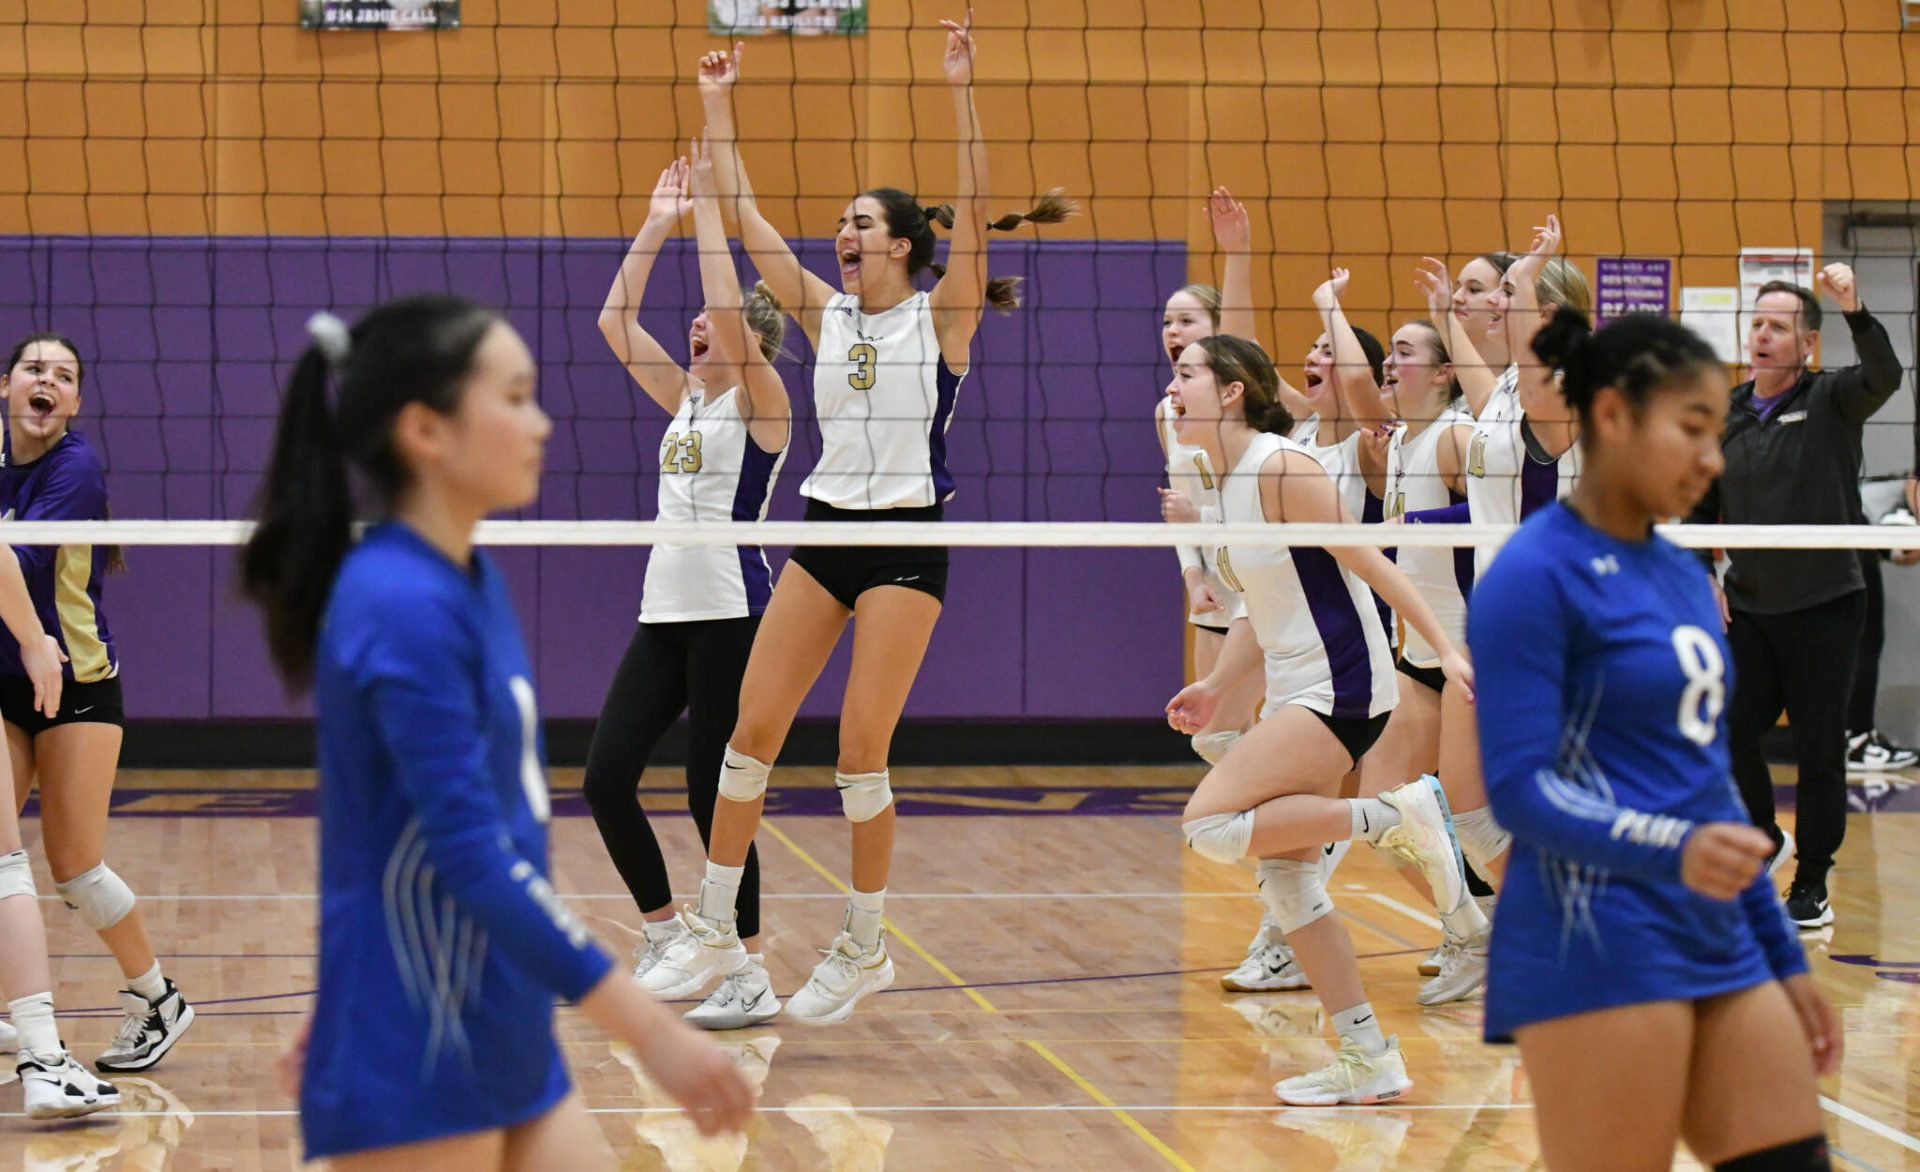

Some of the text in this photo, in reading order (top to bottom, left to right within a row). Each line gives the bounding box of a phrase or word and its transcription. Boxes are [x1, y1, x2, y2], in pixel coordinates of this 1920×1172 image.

[848, 343, 877, 390] 3
[661, 430, 703, 474] 23
[1671, 624, 1725, 747] 8
